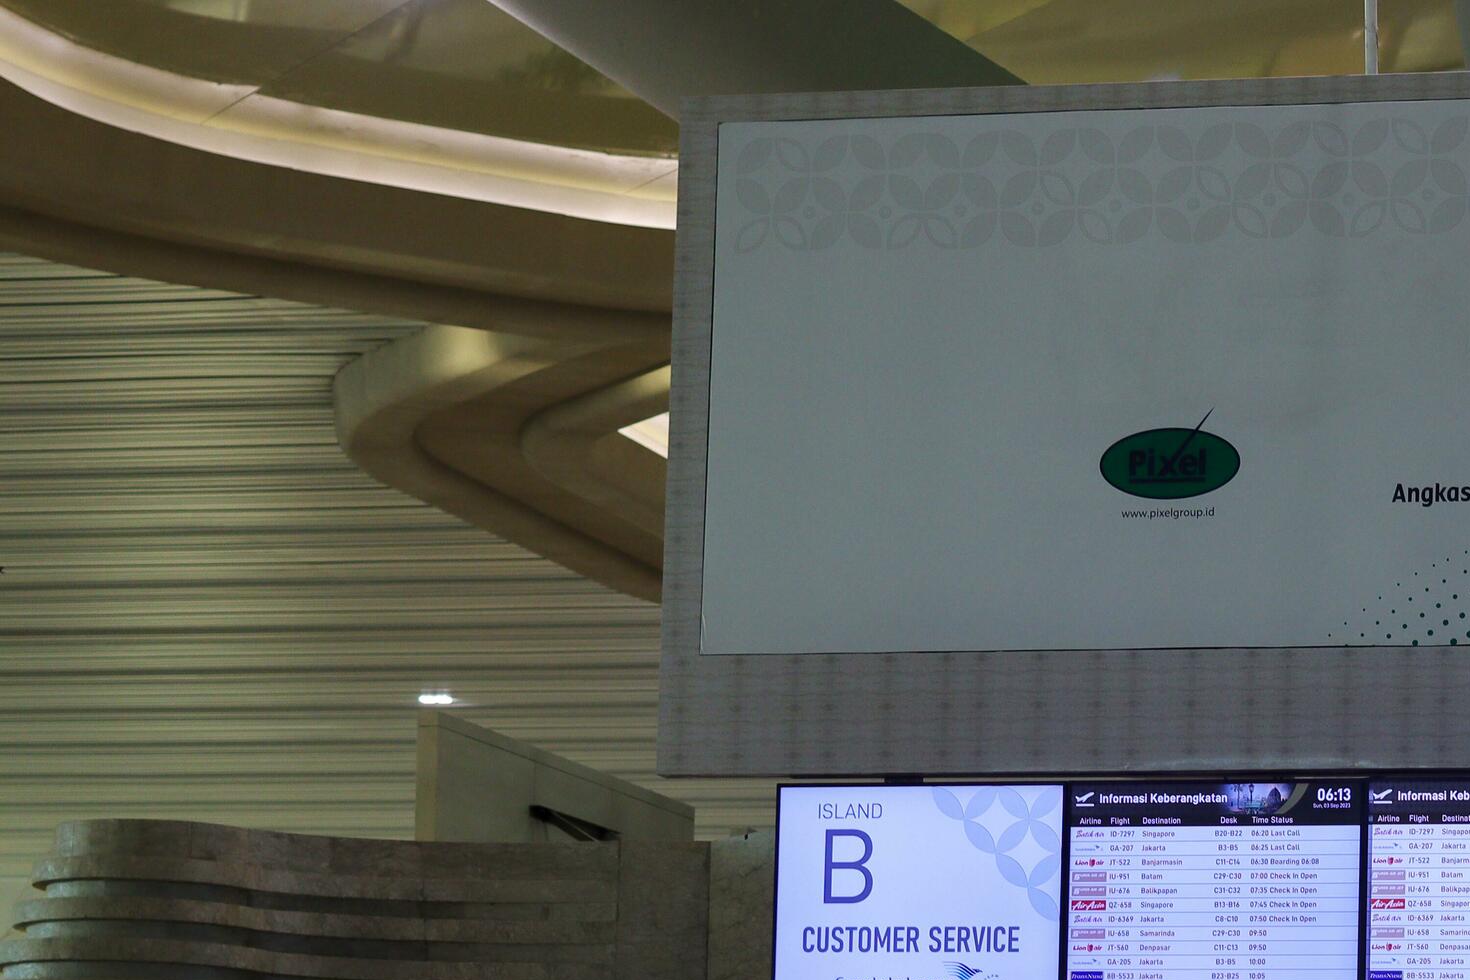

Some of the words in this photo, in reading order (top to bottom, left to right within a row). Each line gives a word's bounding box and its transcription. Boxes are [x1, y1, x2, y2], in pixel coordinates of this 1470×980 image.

[1121, 507, 1215, 520] www.pixelgroup.id
[1099, 793, 1148, 804] Informasi
[1150, 793, 1228, 807] Keberangkatan
[1317, 788, 1351, 801] 06:13
[1398, 791, 1447, 801] Informasi
[818, 803, 882, 819] ISLAND
[1080, 817, 1101, 825] Airline
[1111, 817, 1130, 827] Flight
[1142, 817, 1181, 825] Destination
[1220, 816, 1237, 825] Desk
[1252, 816, 1268, 825] Time
[1271, 816, 1293, 824] Status
[1377, 815, 1400, 823] Airline
[1409, 815, 1429, 824] Flight
[1142, 830, 1175, 839] Singapore
[1142, 844, 1166, 852] Jakarta
[823, 829, 873, 904] B
[1141, 859, 1183, 867] Banjarmasin
[1270, 858, 1300, 866] Boarding
[802, 926, 920, 953] CUSTOMER
[928, 926, 1020, 953] SERVICE
